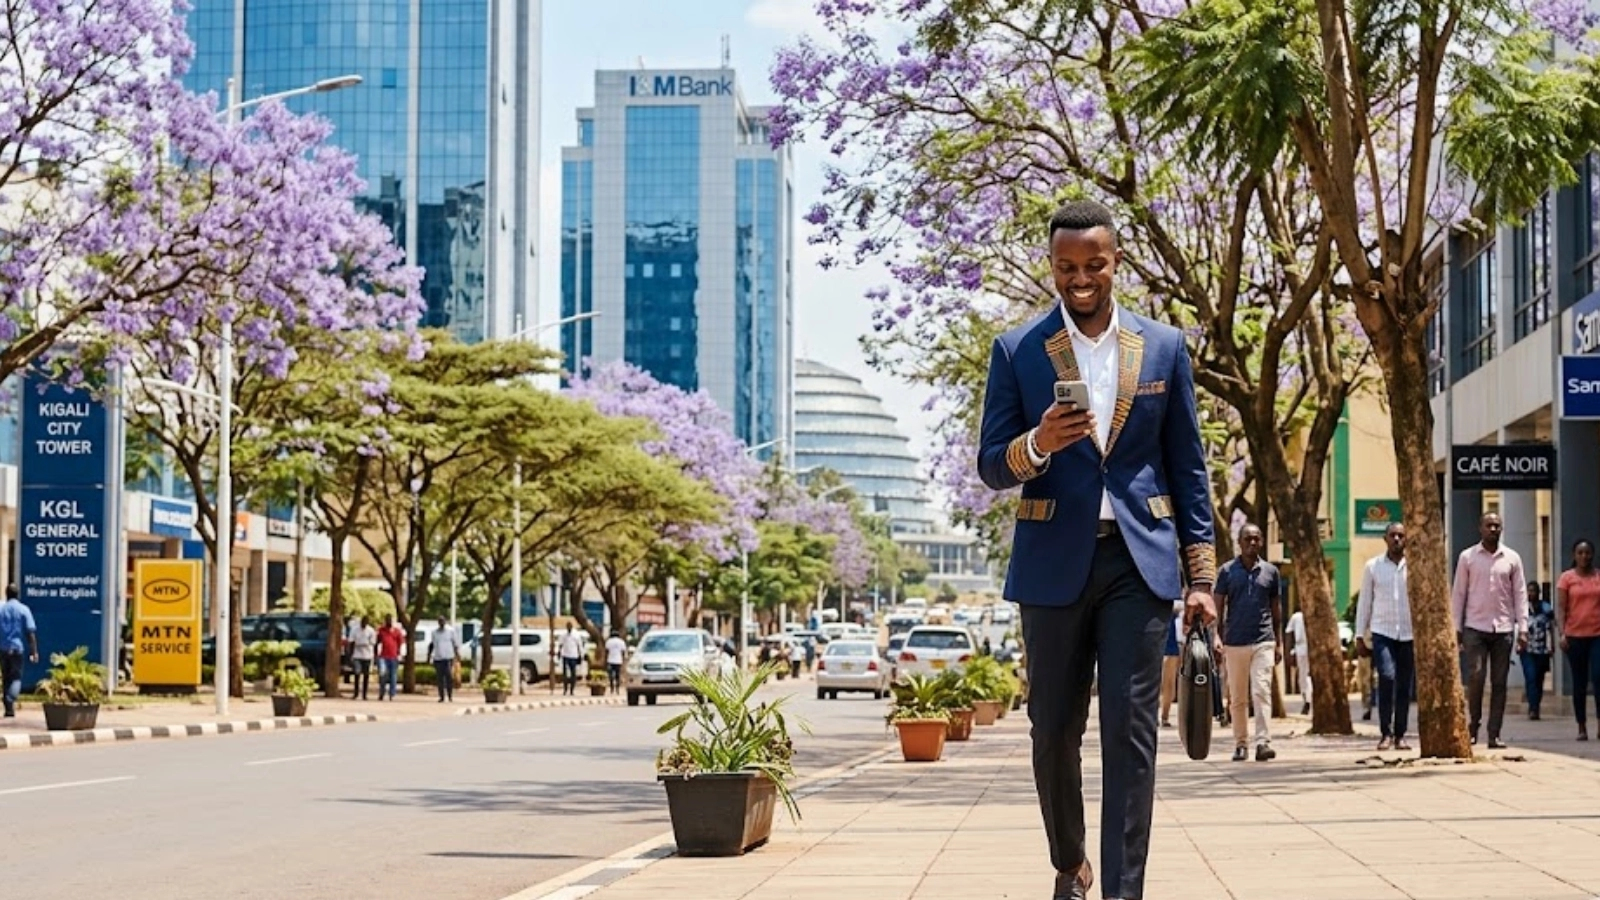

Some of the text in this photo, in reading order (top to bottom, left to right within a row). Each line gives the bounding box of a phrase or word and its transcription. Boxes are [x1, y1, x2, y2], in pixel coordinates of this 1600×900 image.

[679, 75, 733, 96] Bank
[39, 402, 90, 417] KIGALI
[47, 421, 82, 436] CITY
[36, 440, 92, 455] TOWER
[1456, 453, 1548, 473] CAFÉ NOIR
[40, 500, 84, 518] KGL
[25, 523, 99, 538] GENERAL
[36, 543, 88, 557] STORE
[152, 586, 180, 596] MTN
[142, 625, 191, 639] MTN
[140, 642, 191, 654] SERVICE
